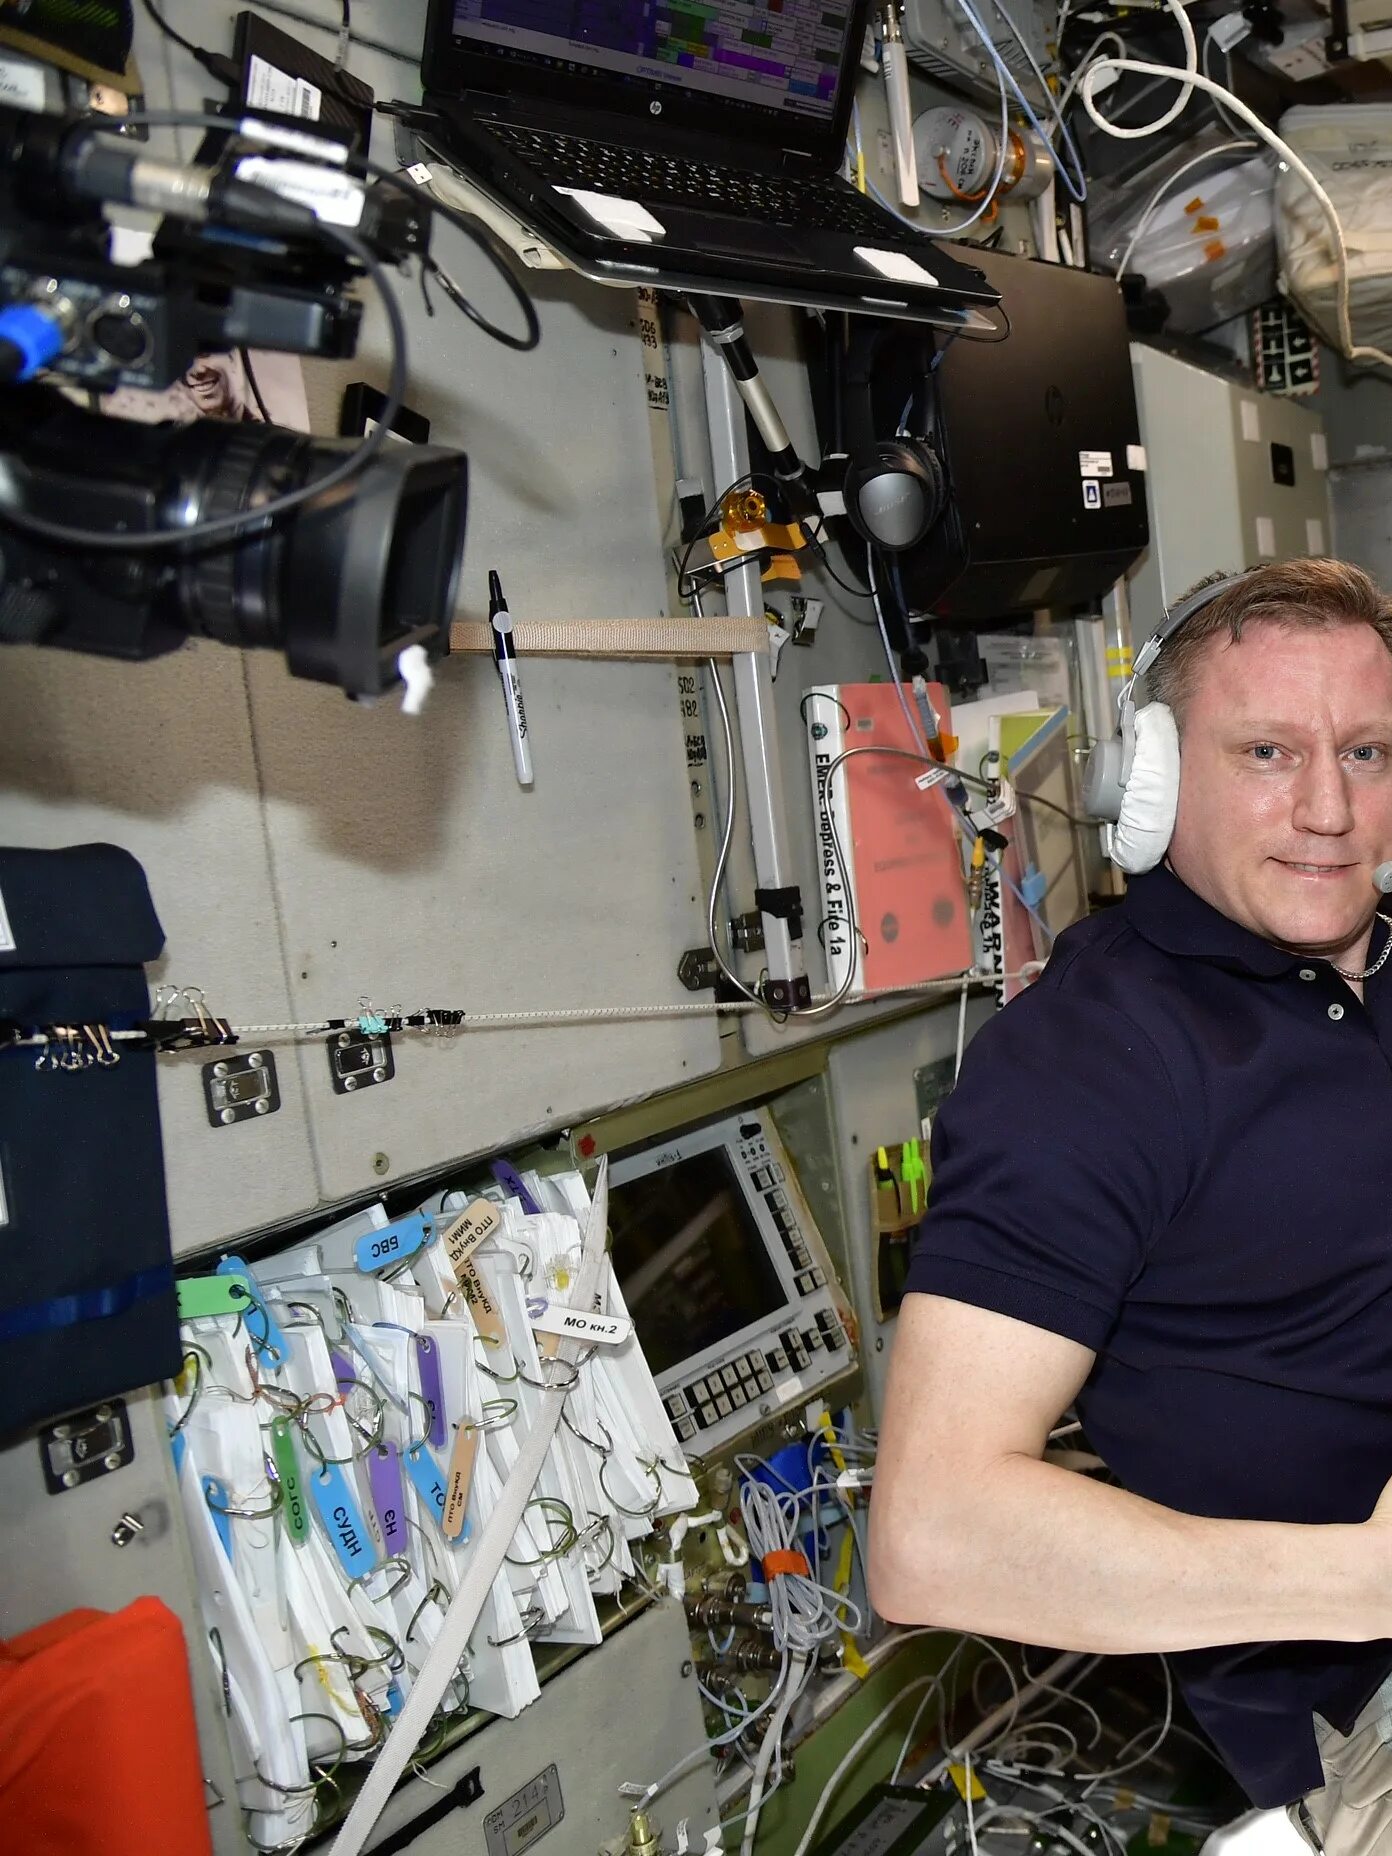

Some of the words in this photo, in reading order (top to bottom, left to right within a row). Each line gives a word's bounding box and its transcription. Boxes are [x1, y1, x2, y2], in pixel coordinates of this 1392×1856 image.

[515, 694, 527, 739] Sharpie
[818, 809, 836, 877] Depress
[825, 881, 841, 893] &
[827, 898, 844, 933] Fire
[829, 937, 846, 956] 1a
[448, 1218, 473, 1245] МИМ1
[475, 1216, 494, 1235] ПТО
[371, 1235, 399, 1258] БВС
[564, 1317, 587, 1329] МО
[590, 1323, 618, 1335] кн.2
[287, 1477, 304, 1530] СОГС
[333, 1506, 363, 1557] СУДН
